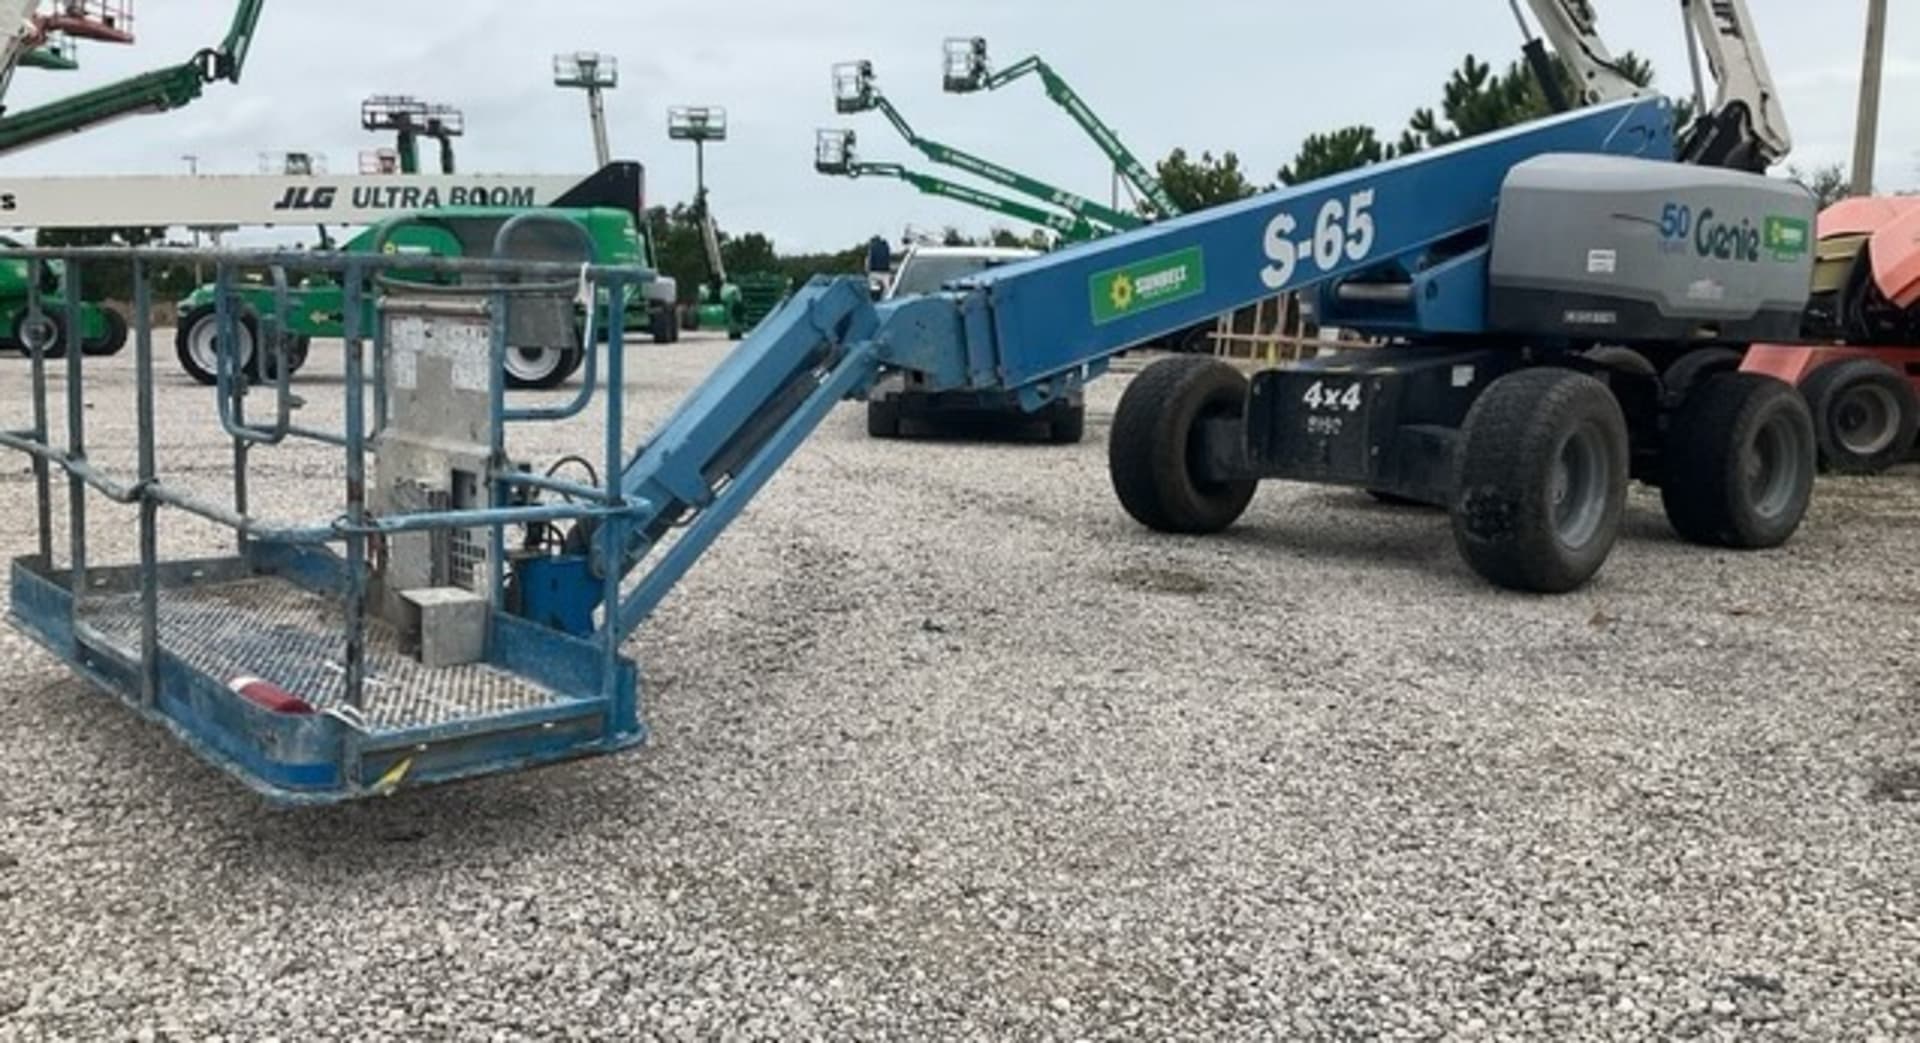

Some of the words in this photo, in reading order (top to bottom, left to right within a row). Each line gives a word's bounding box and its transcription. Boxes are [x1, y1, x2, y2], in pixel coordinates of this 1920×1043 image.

[274, 187, 336, 209] JLG
[351, 186, 441, 208] ULTRA
[450, 186, 536, 208] BOOM
[1660, 203, 1690, 238] 50
[1695, 207, 1760, 262] Genie
[1260, 188, 1374, 289] S-65
[1303, 380, 1361, 411] 4x4
